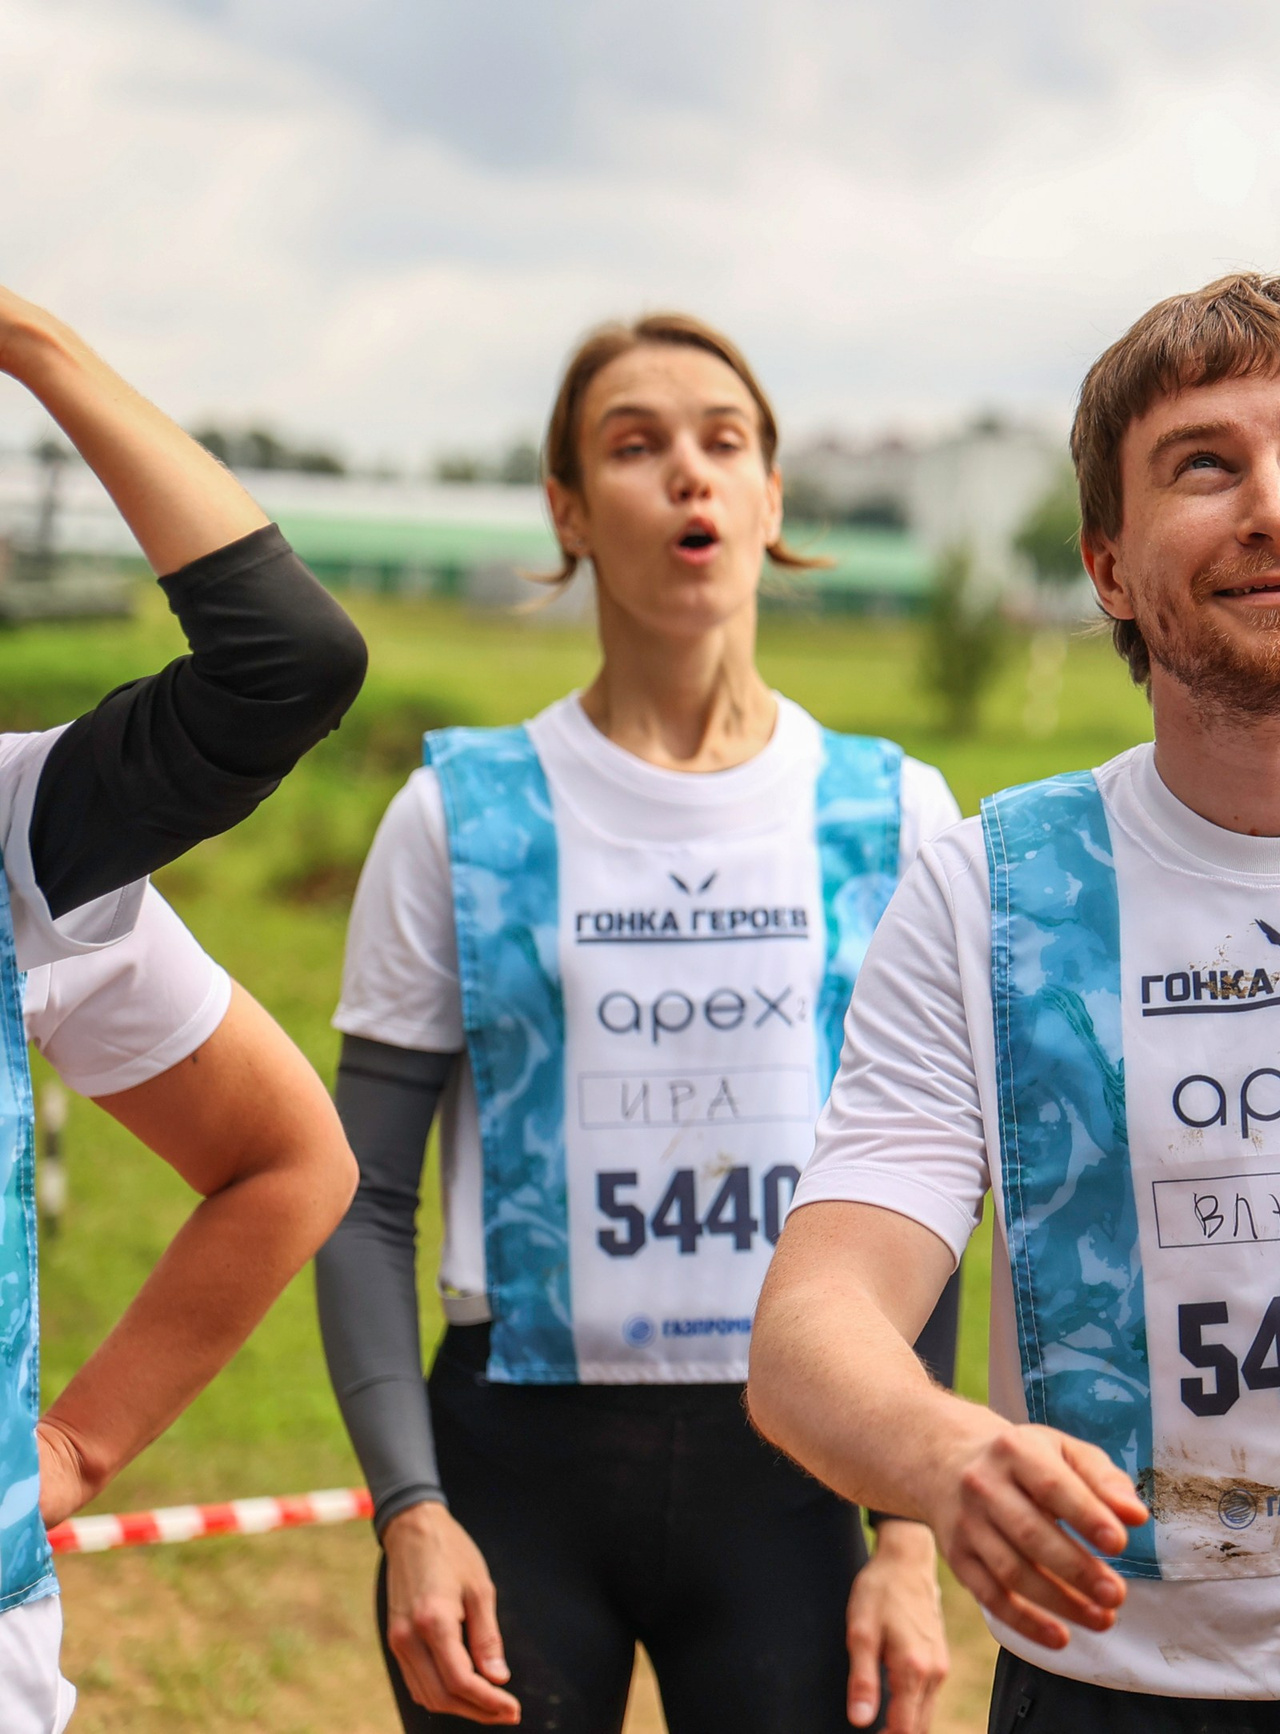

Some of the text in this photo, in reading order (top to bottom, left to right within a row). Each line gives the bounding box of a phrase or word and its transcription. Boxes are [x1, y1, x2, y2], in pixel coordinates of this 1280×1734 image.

[575, 906, 808, 933] ГОНКА ГЕРОЕВ
[1141, 968, 1275, 1004] ГОНКА
[597, 986, 793, 1045] apex
[620, 1078, 739, 1124] ИРА
[596, 1164, 801, 1257] 5440
